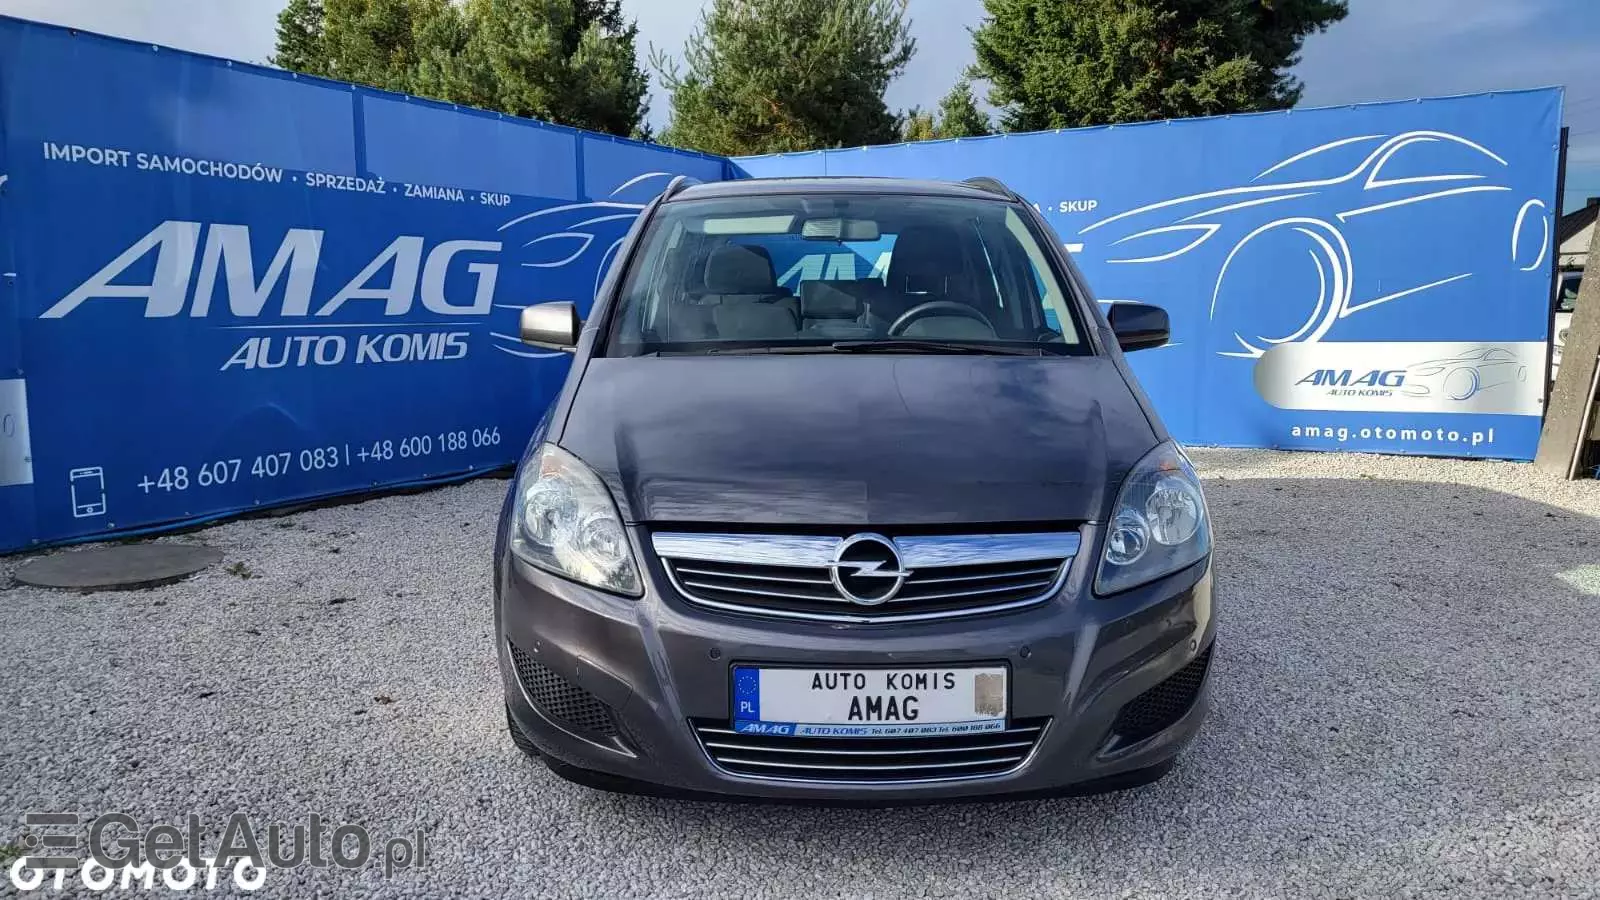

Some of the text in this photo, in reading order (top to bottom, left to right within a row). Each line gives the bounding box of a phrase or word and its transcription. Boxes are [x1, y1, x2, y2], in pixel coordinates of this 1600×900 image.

[43, 142, 511, 207] IMPORT SAMOCHODÓW SPRZEDAŻ ZAMIANA SKUP
[1059, 199, 1098, 213] SKUP
[220, 332, 470, 371] AUTO KOMIS
[1327, 389, 1393, 397] AUTO KOMIS
[1291, 425, 1495, 446] amag.otomoto.pl
[138, 426, 501, 494] +48 607 407 083 +48 600 188 066
[811, 672, 956, 690] AUTO KOMIS
[740, 701, 756, 713] PL
[848, 695, 919, 721] AMAG
[739, 723, 791, 735] AMAG
[800, 727, 831, 735] AUTO
